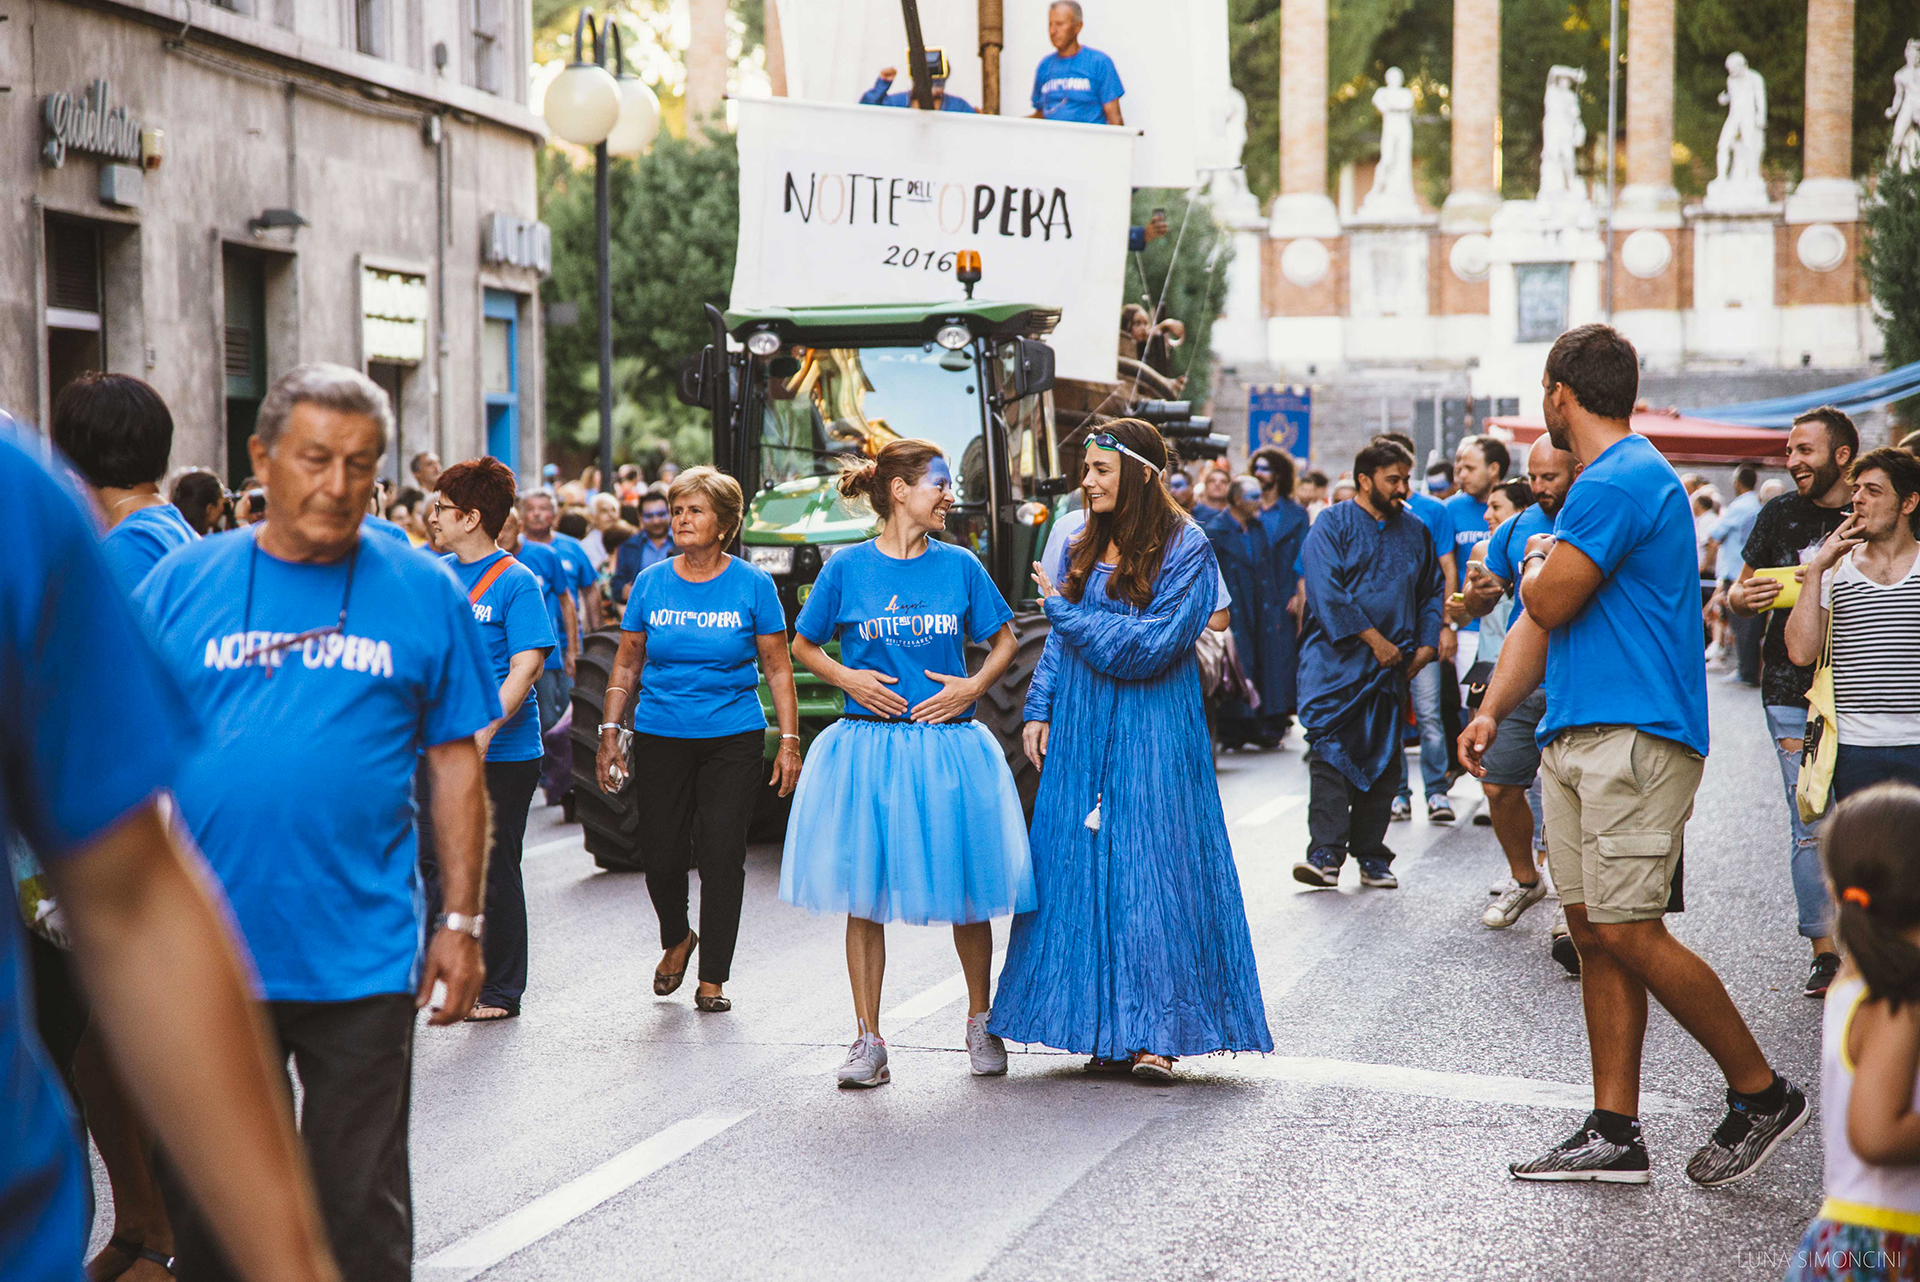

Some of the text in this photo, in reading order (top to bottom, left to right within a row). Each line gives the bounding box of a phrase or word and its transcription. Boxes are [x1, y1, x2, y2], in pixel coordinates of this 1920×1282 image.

[784, 171, 1072, 241] NOTTE DELL' OPERA
[883, 245, 957, 272] 2016
[472, 603, 492, 622] ERA
[884, 594, 900, 614] 4
[649, 608, 688, 627] NOTTE
[697, 611, 742, 628] OPERA
[858, 616, 900, 642] NOTTE
[911, 613, 958, 636] OPERA
[302, 632, 395, 679] OPERA
